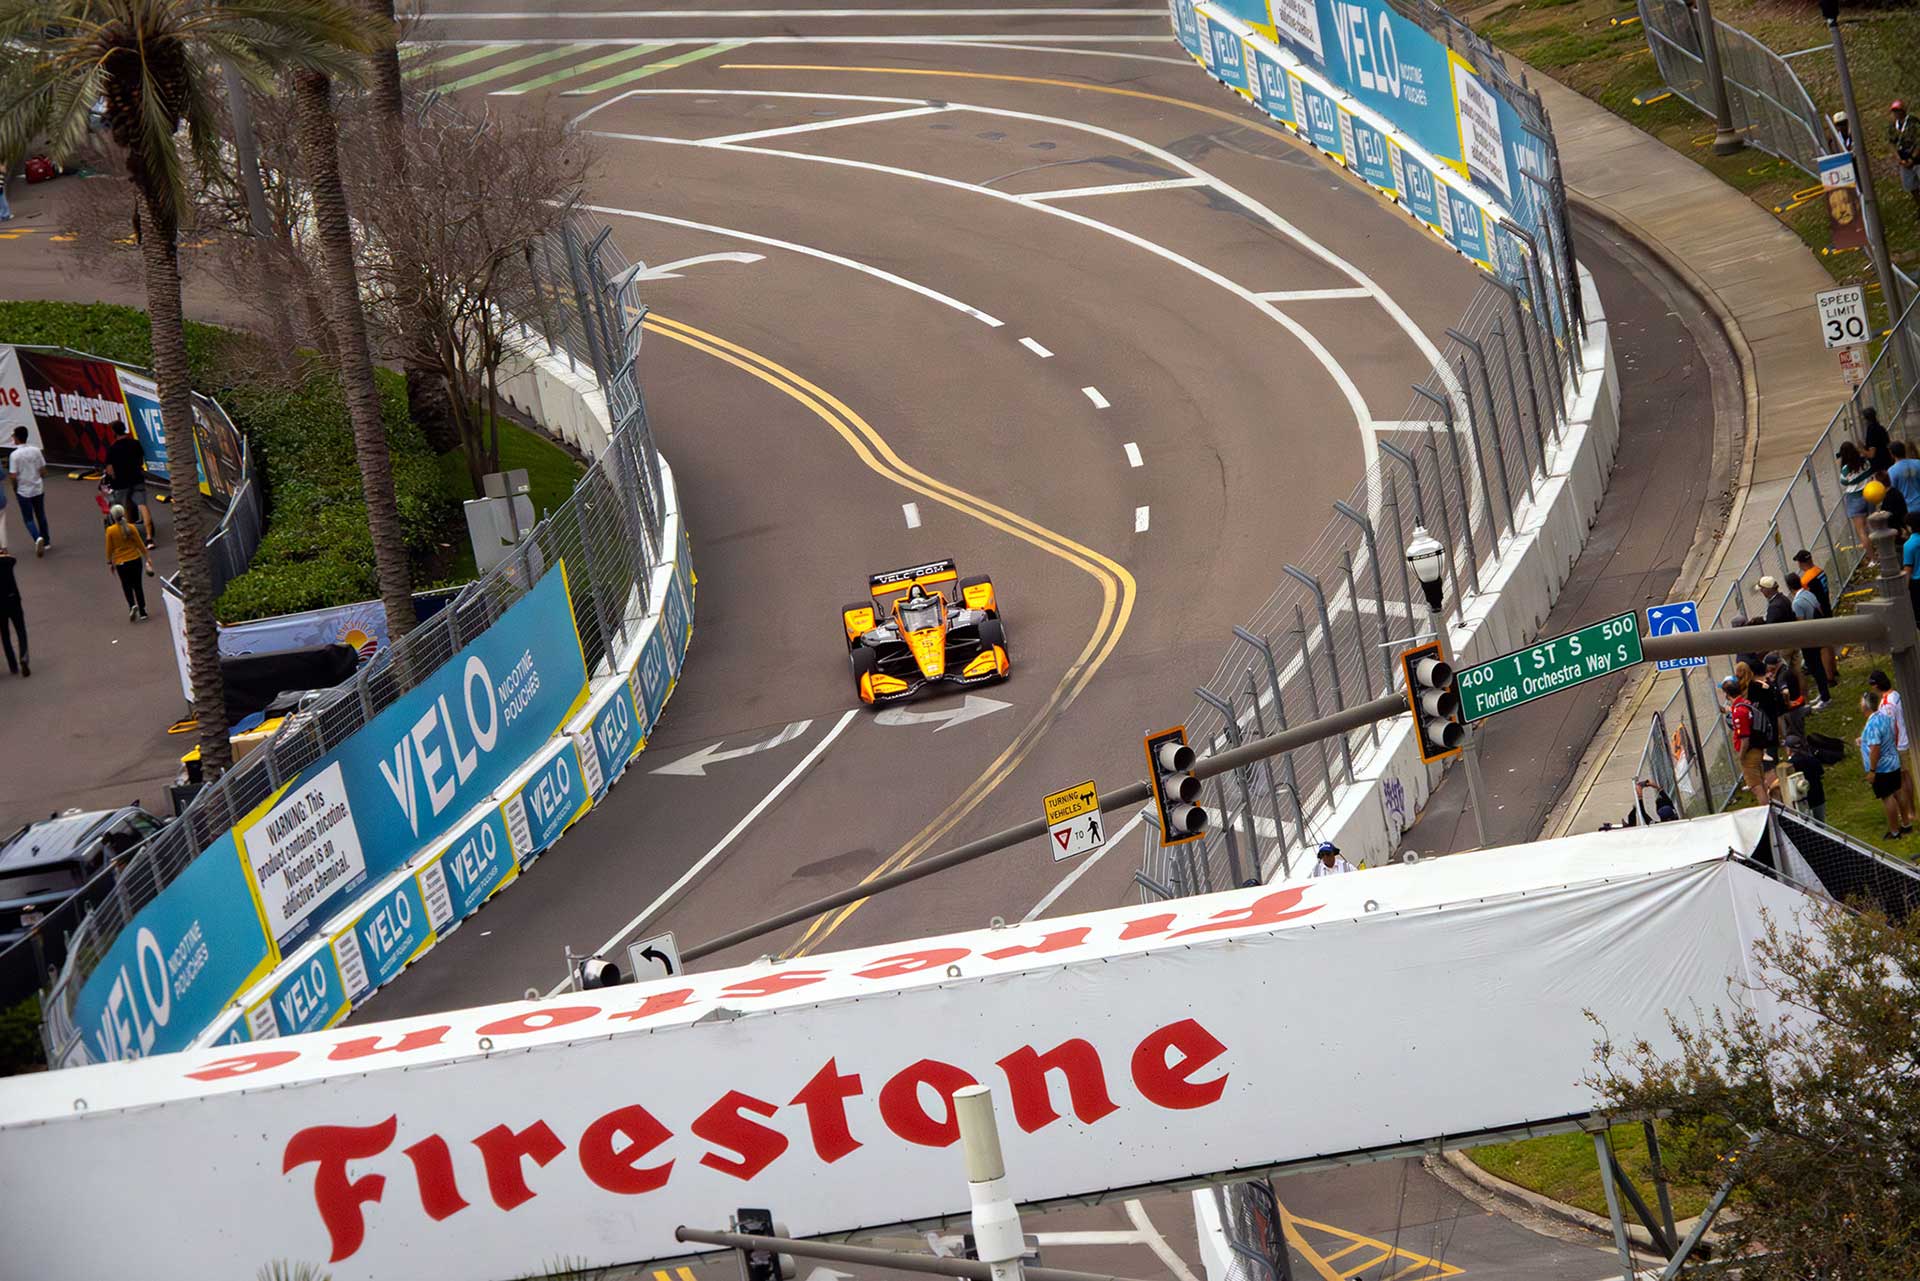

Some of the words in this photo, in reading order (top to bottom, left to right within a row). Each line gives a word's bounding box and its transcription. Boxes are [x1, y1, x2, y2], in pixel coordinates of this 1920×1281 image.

[1212, 29, 1239, 67] VELO
[1330, 0, 1400, 99] VELO
[1259, 62, 1285, 99] VELO
[1305, 93, 1333, 132] VELO
[1355, 128, 1384, 165] VELO
[1404, 162, 1432, 202] VELO
[1452, 199, 1479, 238] VELO
[1820, 292, 1859, 307] SPEED
[1826, 304, 1856, 318] LIMIT
[1827, 316, 1864, 340] 30
[498, 648, 535, 705] NICOTINE
[641, 635, 662, 695] VELO
[1461, 666, 1494, 690] 400
[1513, 657, 1523, 676] 1
[1532, 643, 1557, 670] ST
[1569, 636, 1583, 656] S
[1602, 617, 1634, 641] 500
[1475, 683, 1518, 712] Florida
[1522, 665, 1582, 695] Orchestra
[1585, 651, 1612, 674] Way
[1617, 644, 1628, 662] S
[1659, 656, 1706, 669] BEGIN
[504, 671, 541, 728] POUCHES
[597, 694, 629, 760] VELO
[379, 655, 498, 838] VELO
[266, 800, 308, 846] WARNING:
[305, 789, 325, 816] This
[529, 756, 571, 826] VELO
[1049, 791, 1079, 808] TURNING
[1049, 803, 1082, 820] VEHICLES
[257, 846, 288, 888] product
[286, 824, 317, 861] contains
[315, 801, 349, 835] nicotine.
[449, 822, 496, 893] VELO
[1075, 830, 1085, 840] TO
[282, 880, 315, 920] addictive
[313, 850, 350, 894] chemical.
[283, 853, 317, 890] Nicotine
[316, 844, 324, 860] is
[323, 839, 334, 857] an
[167, 919, 203, 977] NICOTINE
[364, 890, 411, 961] VELO
[174, 942, 209, 1001] POUCHES
[184, 884, 1328, 1083] Firestone
[280, 959, 327, 1033] VELO
[282, 1018, 1229, 1263] Firestone
